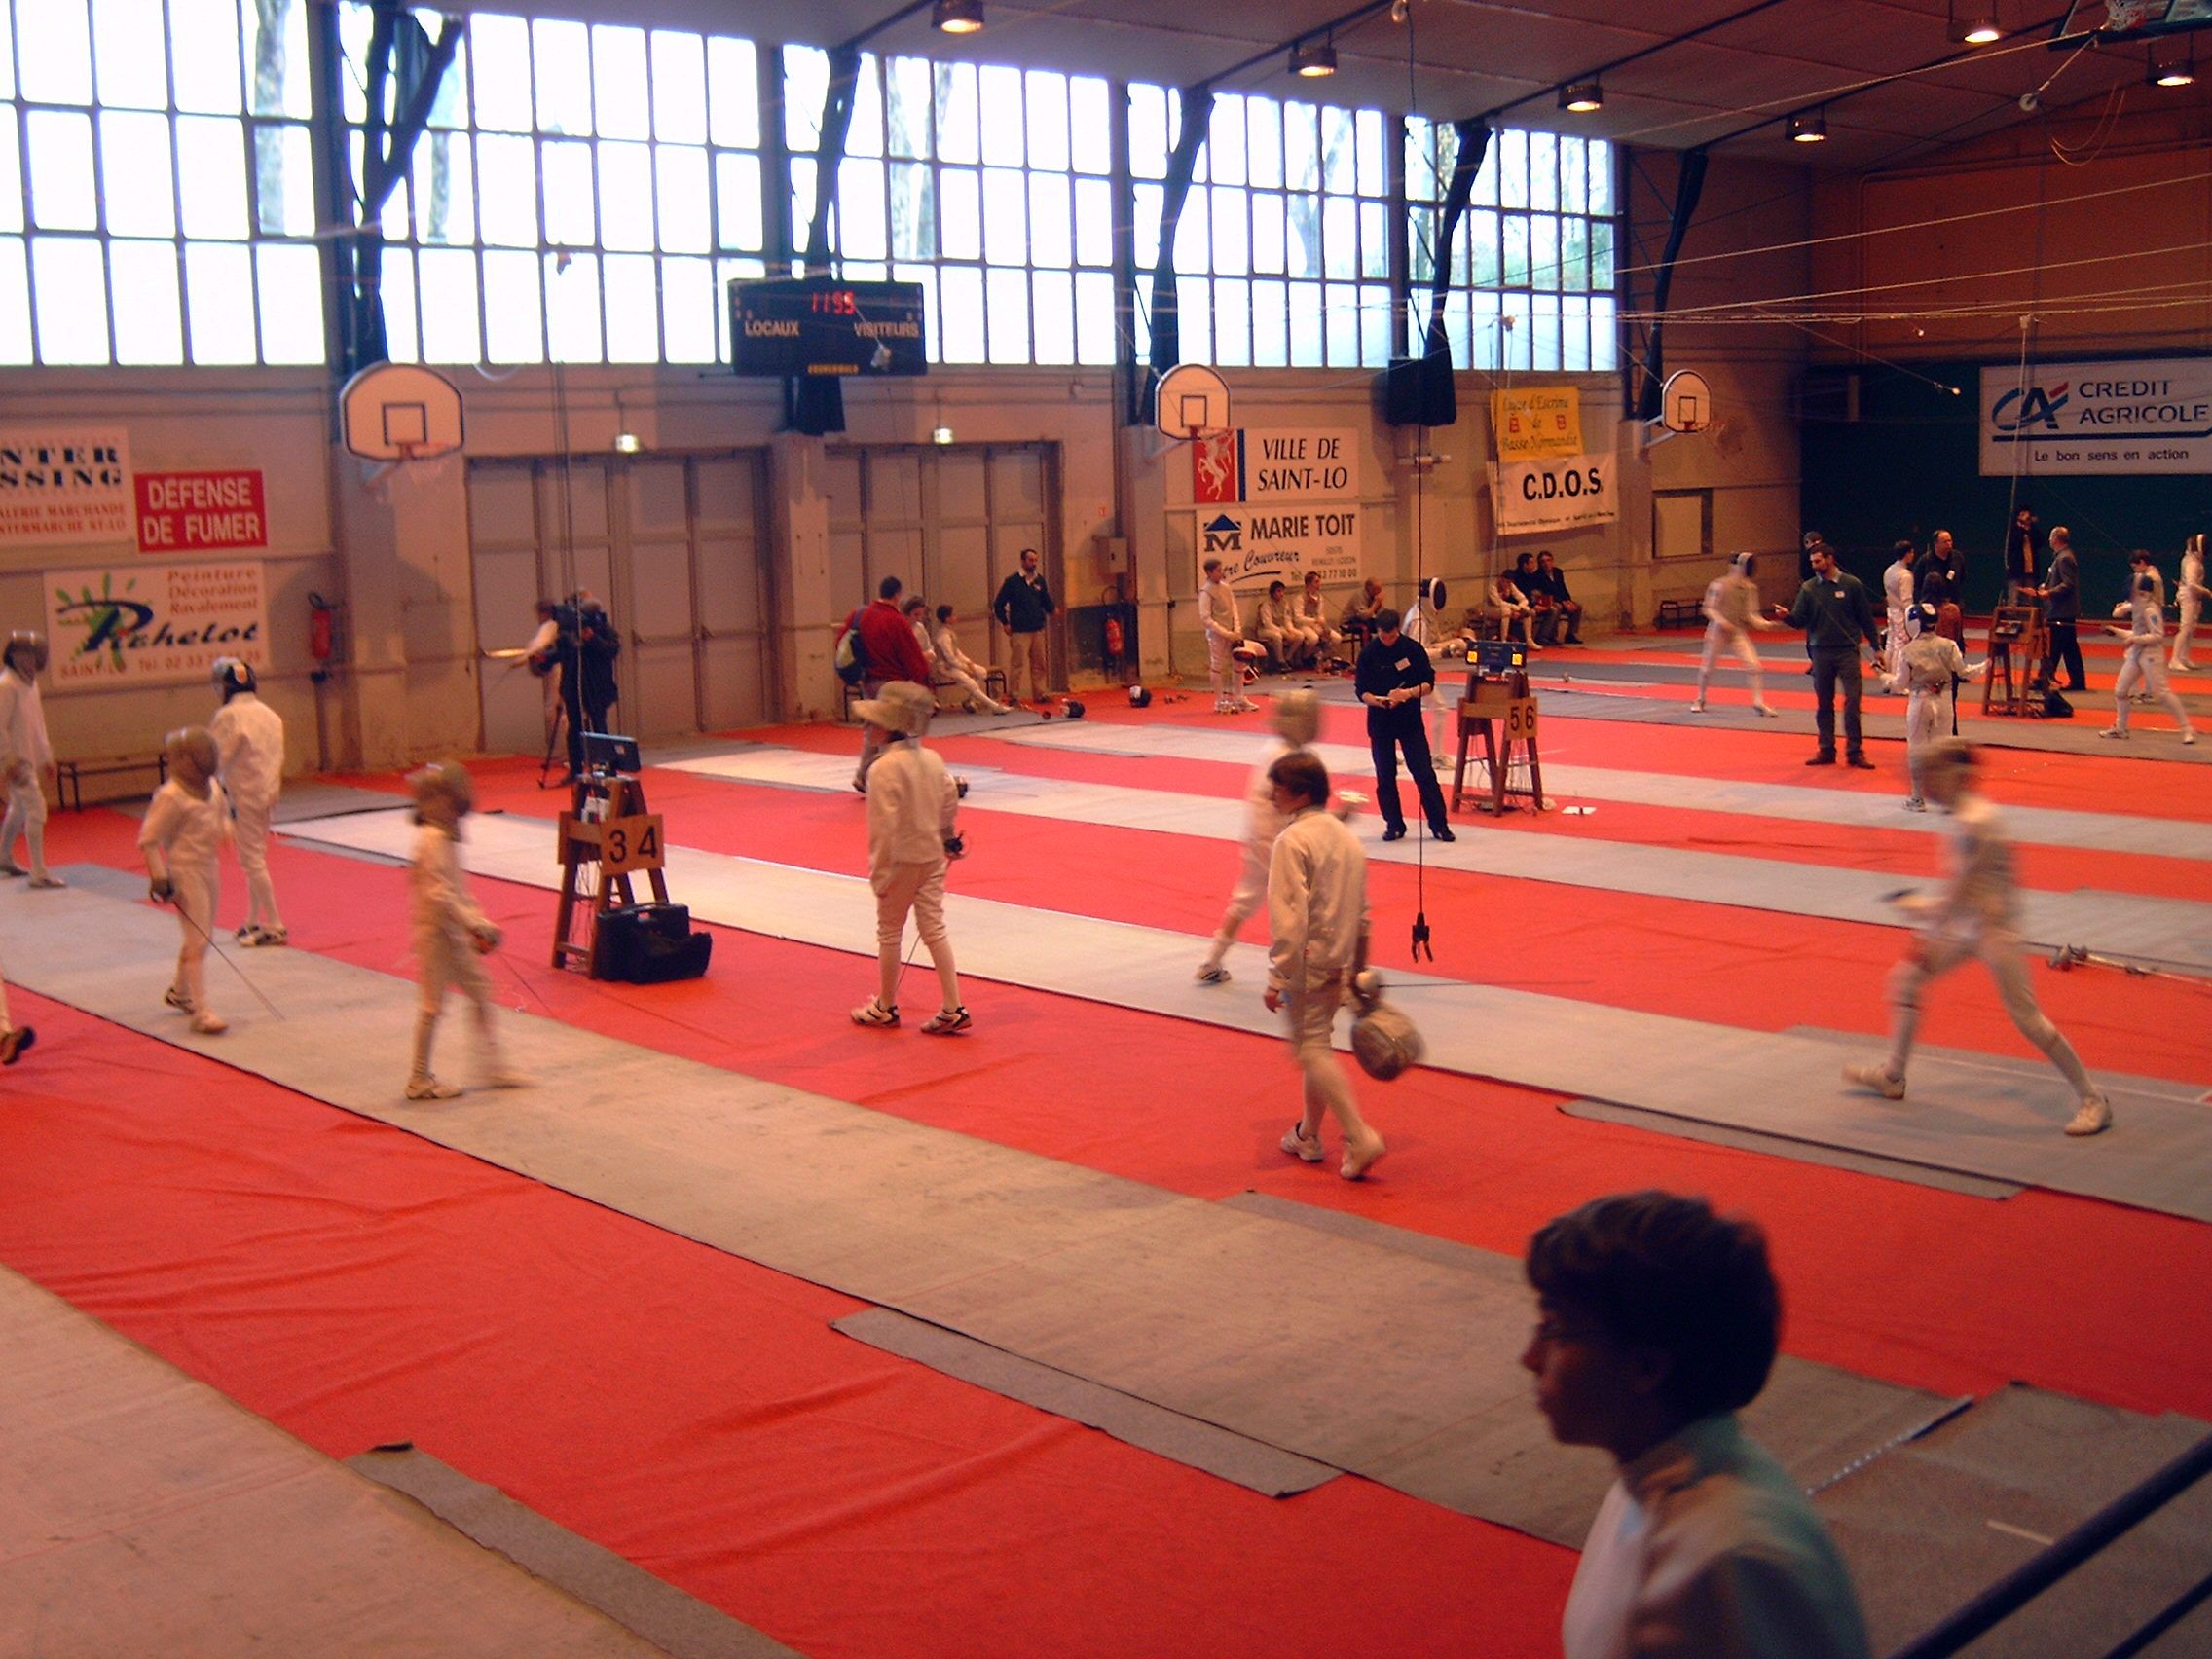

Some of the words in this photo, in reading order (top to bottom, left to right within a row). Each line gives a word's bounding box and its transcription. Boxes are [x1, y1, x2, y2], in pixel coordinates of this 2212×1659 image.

[744, 319, 800, 337] LOCAUX
[854, 321, 920, 338] VISITEURS
[2079, 380, 2171, 398] CREDIT
[2079, 404, 2209, 424] AGRICOLE
[1263, 438, 1307, 460] VILLE
[1317, 438, 1341, 459] DE
[2034, 449, 2048, 461] Le
[2056, 450, 2080, 461] bon
[2087, 451, 2118, 461] sens
[2123, 451, 2140, 461] en
[2148, 448, 2189, 460] action
[1258, 467, 1348, 492] SAINT-LO
[142, 515, 175, 545] DE
[184, 511, 262, 544] FUMER
[1250, 515, 1309, 540] MARIE
[1315, 513, 1355, 536] TOIT
[167, 568, 256, 583] Peinture
[168, 583, 258, 600] Décoration
[169, 599, 258, 615] Ravalement
